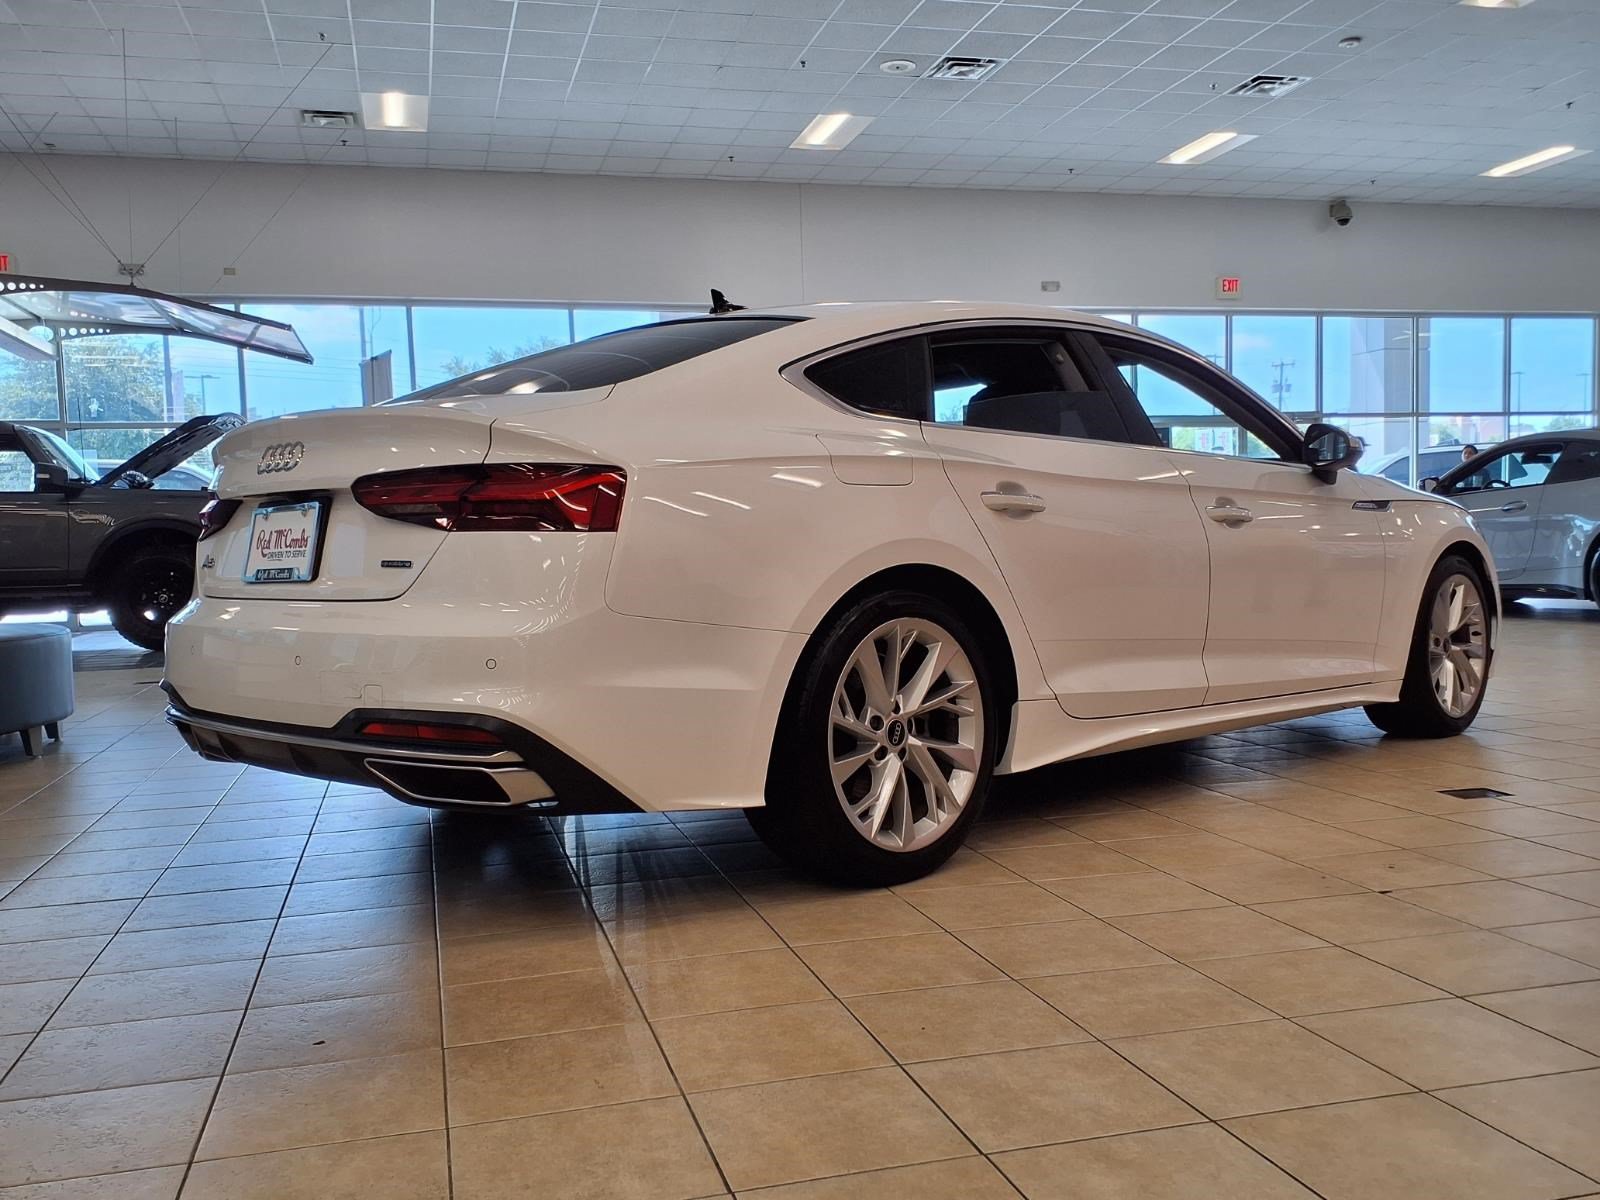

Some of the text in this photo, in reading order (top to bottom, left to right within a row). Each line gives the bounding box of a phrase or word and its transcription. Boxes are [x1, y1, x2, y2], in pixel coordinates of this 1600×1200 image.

[1222, 279, 1238, 292] EXIT
[256, 528, 308, 558] Red McCombs
[267, 550, 306, 559] DRIVEN TO SERVE
